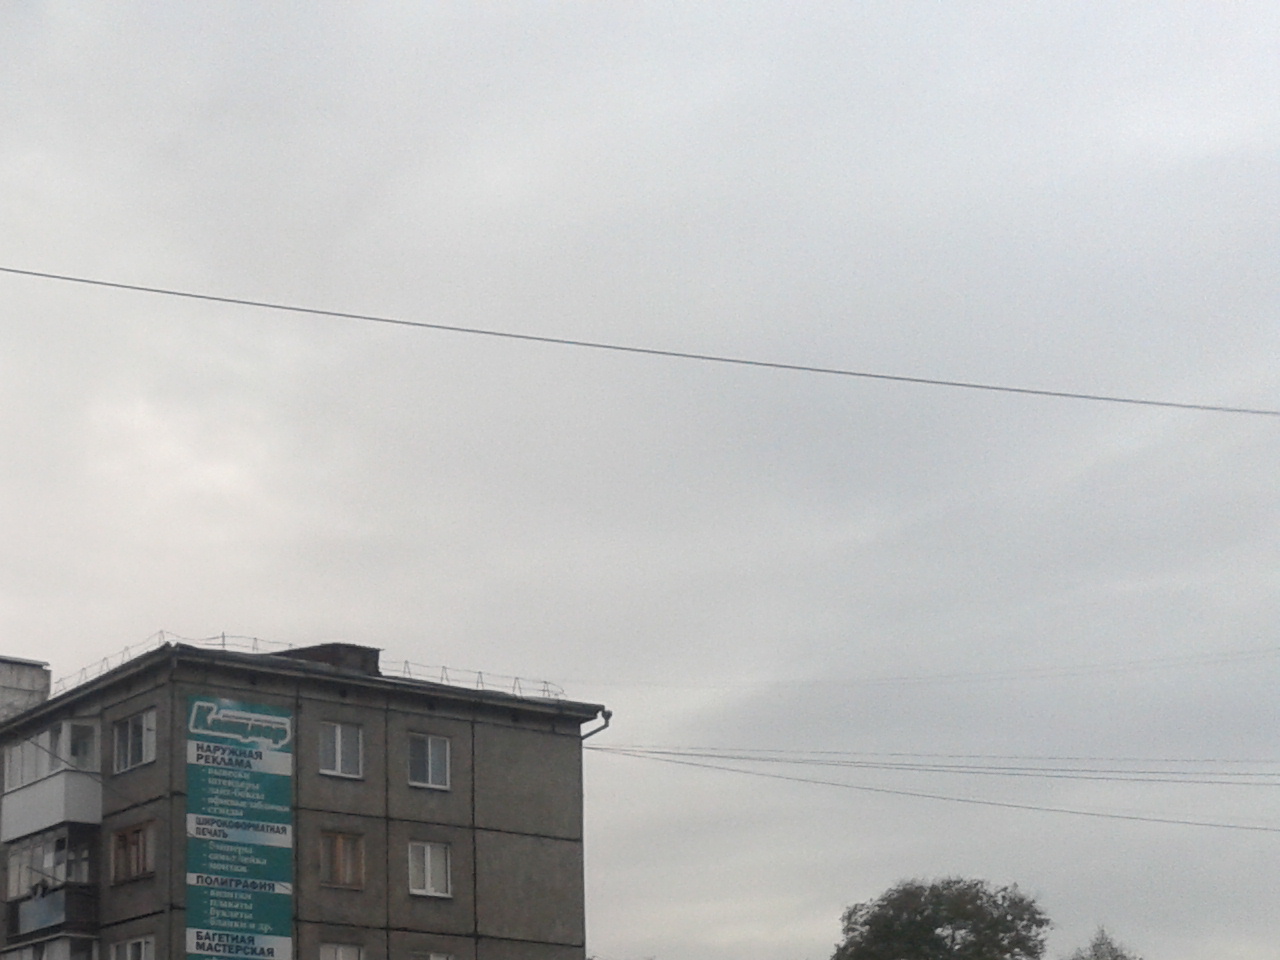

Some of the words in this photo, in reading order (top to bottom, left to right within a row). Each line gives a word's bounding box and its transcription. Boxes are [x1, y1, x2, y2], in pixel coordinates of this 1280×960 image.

[196, 743, 263, 761] НАРУЖНАЯ
[196, 753, 253, 769] РЕКЛАМА
[196, 817, 288, 836] ШИРОКОФОРМАТНАЯ
[196, 827, 229, 839] ПЕЧАТЬ
[196, 875, 275, 892] ПОЛИГРАФИЯ
[209, 900, 253, 910] плакаты
[196, 931, 255, 946] БАГЕТНАЯ
[196, 941, 275, 957] МАСТЕРСКАЯ
